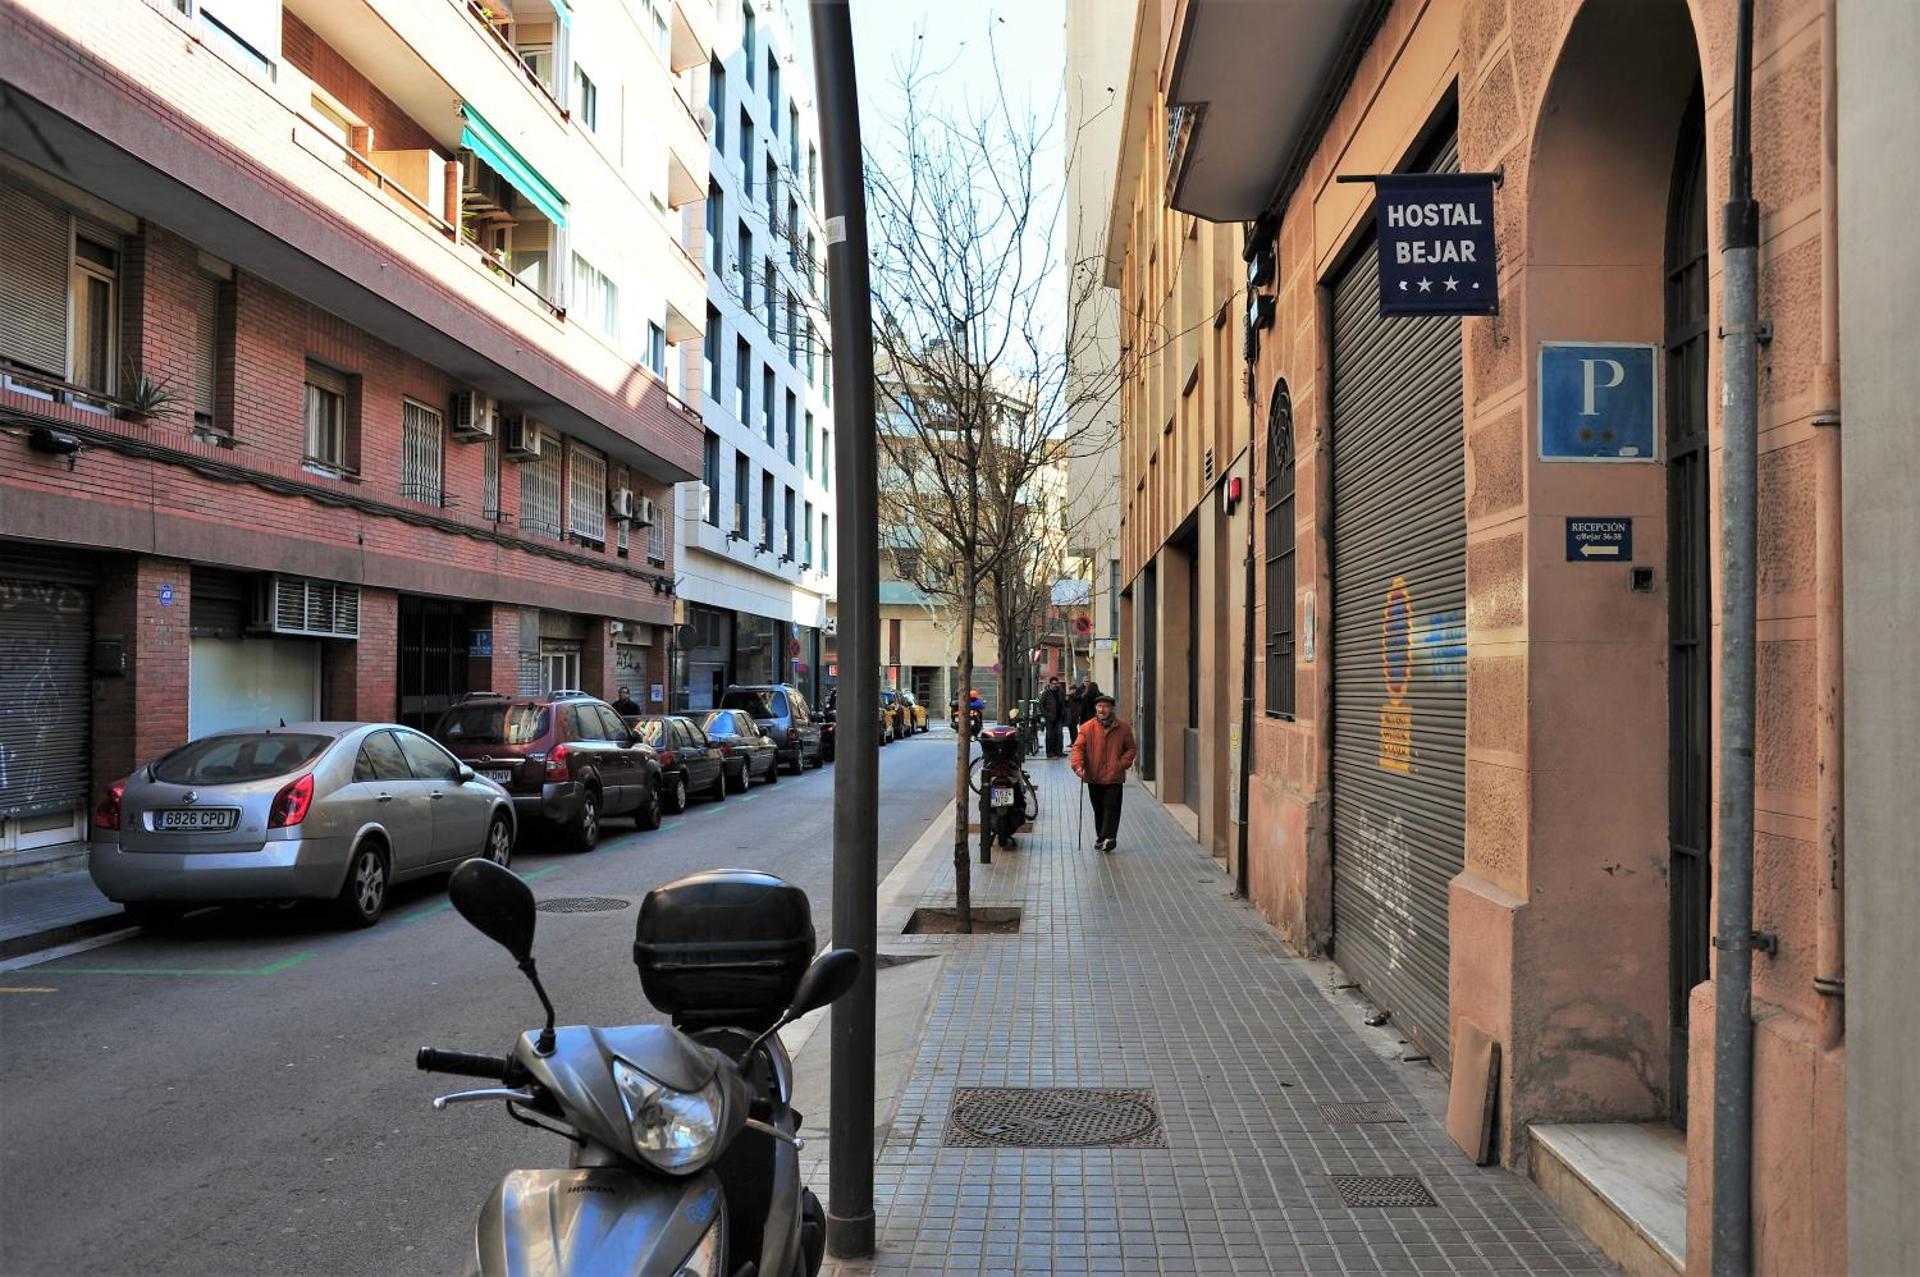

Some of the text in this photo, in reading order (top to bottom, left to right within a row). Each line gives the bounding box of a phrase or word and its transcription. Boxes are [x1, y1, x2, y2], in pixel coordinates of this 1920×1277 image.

[1388, 203, 1482, 228] HOSTAL
[1396, 240, 1477, 264] BEJAR
[1578, 359, 1625, 416] P
[1571, 521, 1625, 532] RECEPCIÓN
[166, 811, 225, 826] 6826 CPD
[567, 1185, 616, 1194] HONDA
